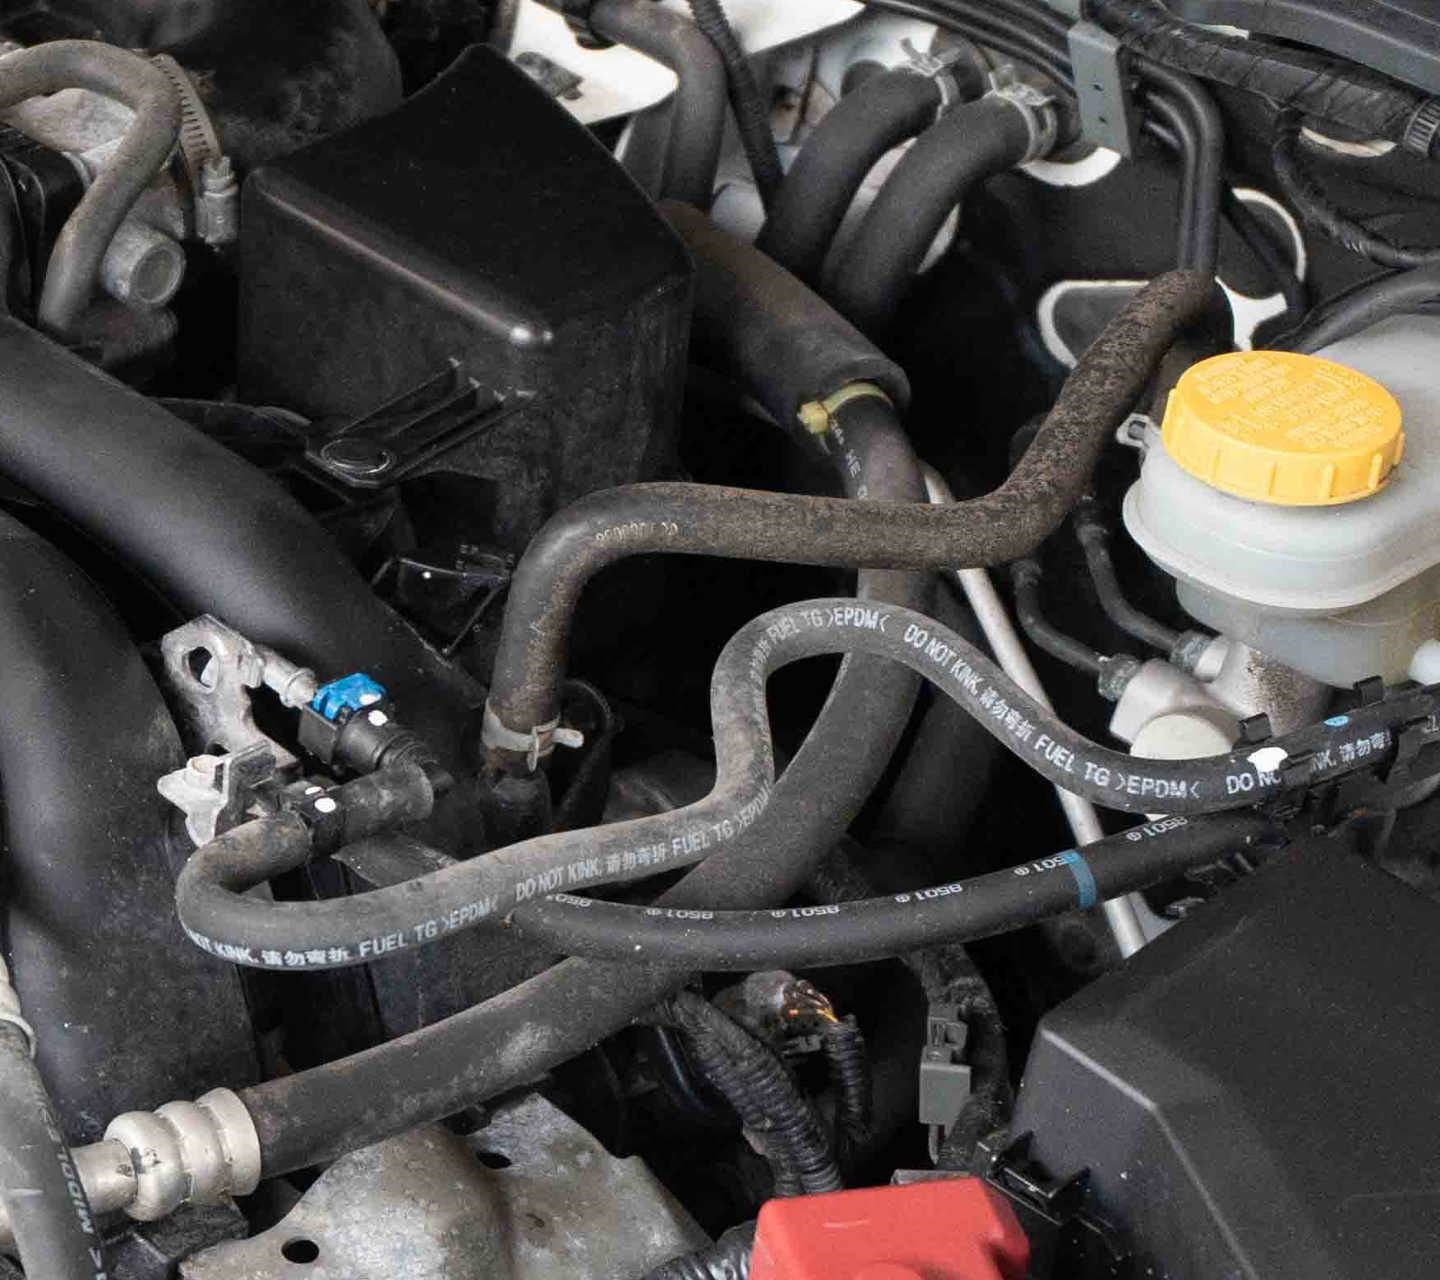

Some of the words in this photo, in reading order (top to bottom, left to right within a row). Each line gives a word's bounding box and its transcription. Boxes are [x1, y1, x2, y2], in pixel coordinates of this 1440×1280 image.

[903, 624, 929, 648] DO
[925, 637, 957, 667] NOT
[1033, 733, 1076, 774] FUEL
[1083, 761, 1111, 788] TG
[1225, 771, 1254, 795] DO
[515, 877, 537, 902] DO
[536, 866, 565, 893] NOT
[671, 830, 711, 856] FUEL
[711, 819, 734, 843] TG
[921, 882, 964, 902] 8501
[793, 904, 840, 919] 8501
[358, 931, 409, 959] FUEL
[412, 920, 437, 942] TG
